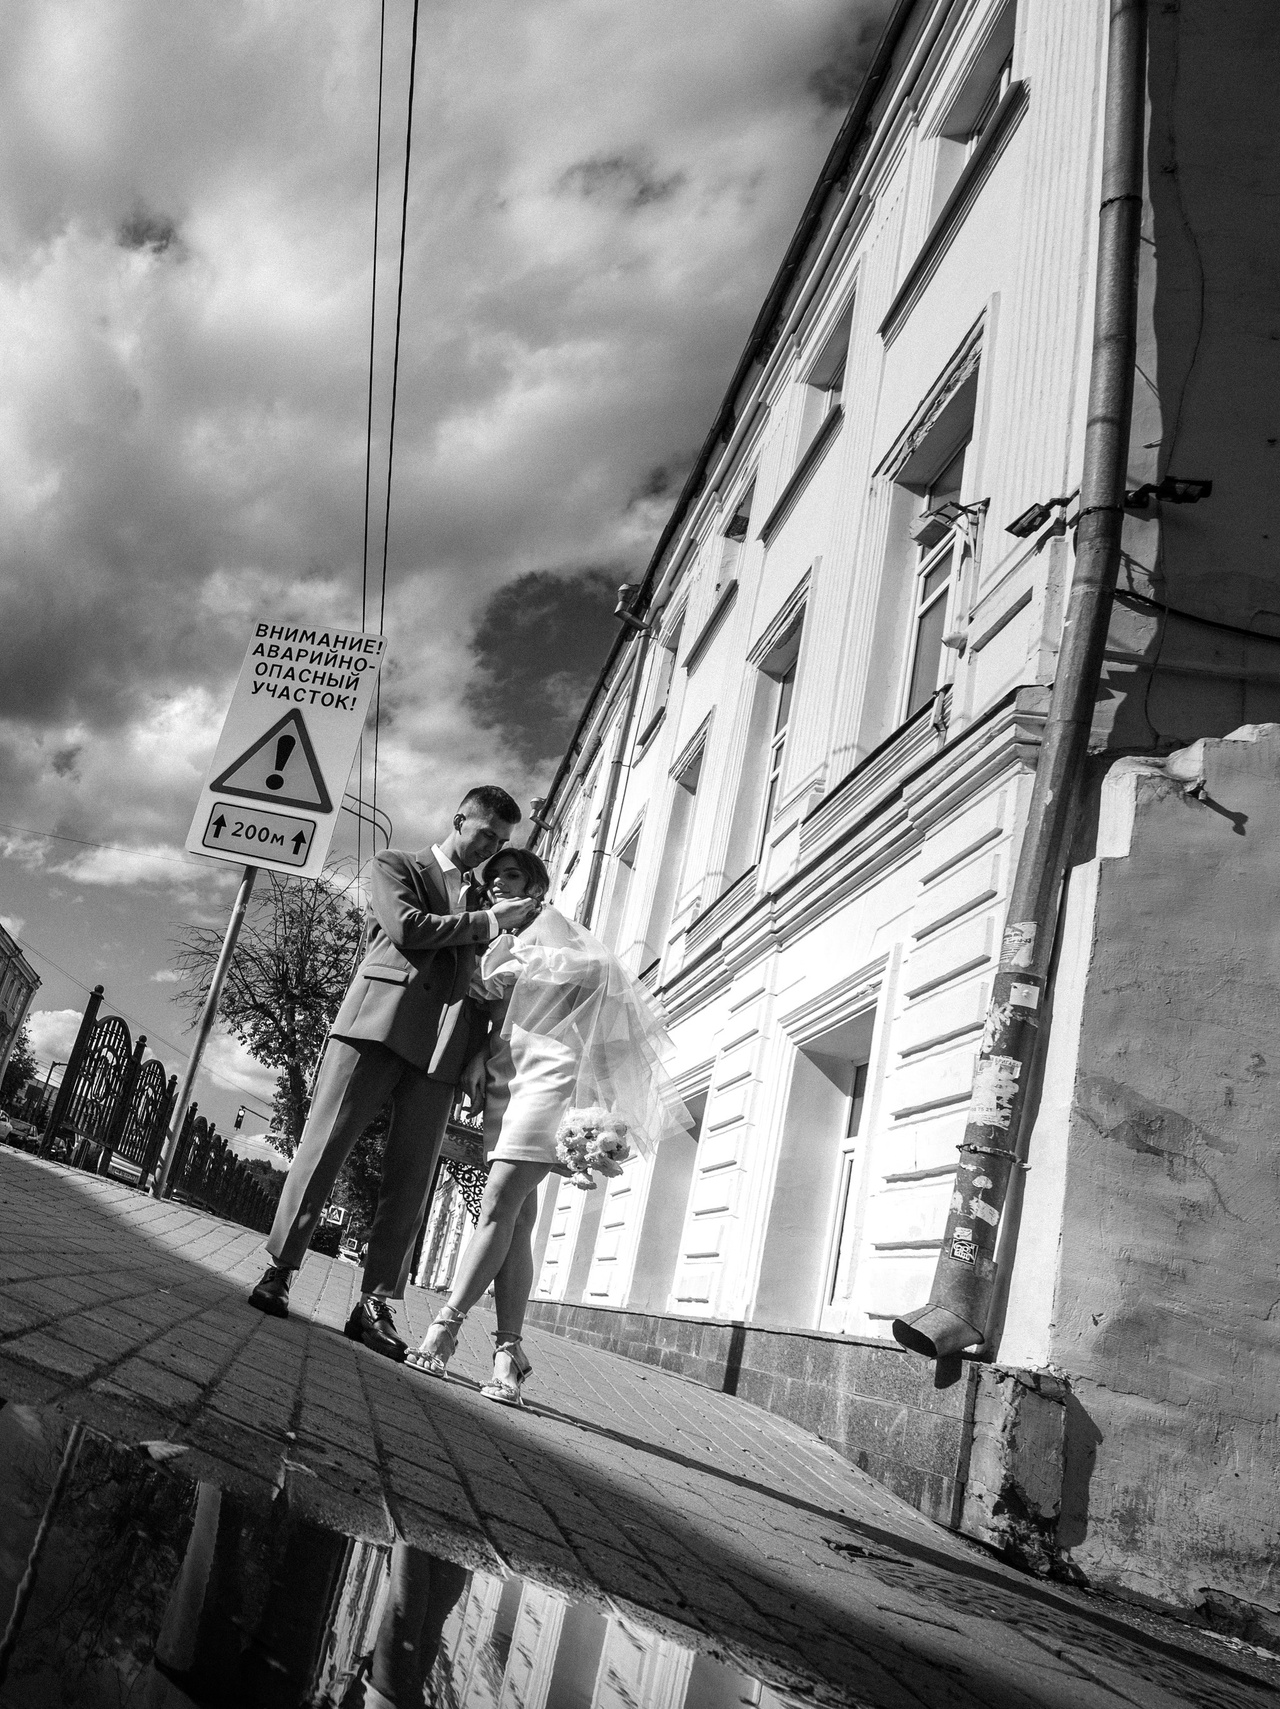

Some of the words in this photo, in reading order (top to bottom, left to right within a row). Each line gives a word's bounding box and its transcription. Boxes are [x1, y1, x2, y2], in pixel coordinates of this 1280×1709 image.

[255, 623, 383, 655] ВНИМАНИЕ!
[252, 643, 376, 672] АВАРИЙНО-
[255, 662, 360, 691] ОПАСНЫЙ
[251, 680, 357, 711] УЧАСТОК!
[231, 821, 285, 846] 200м
